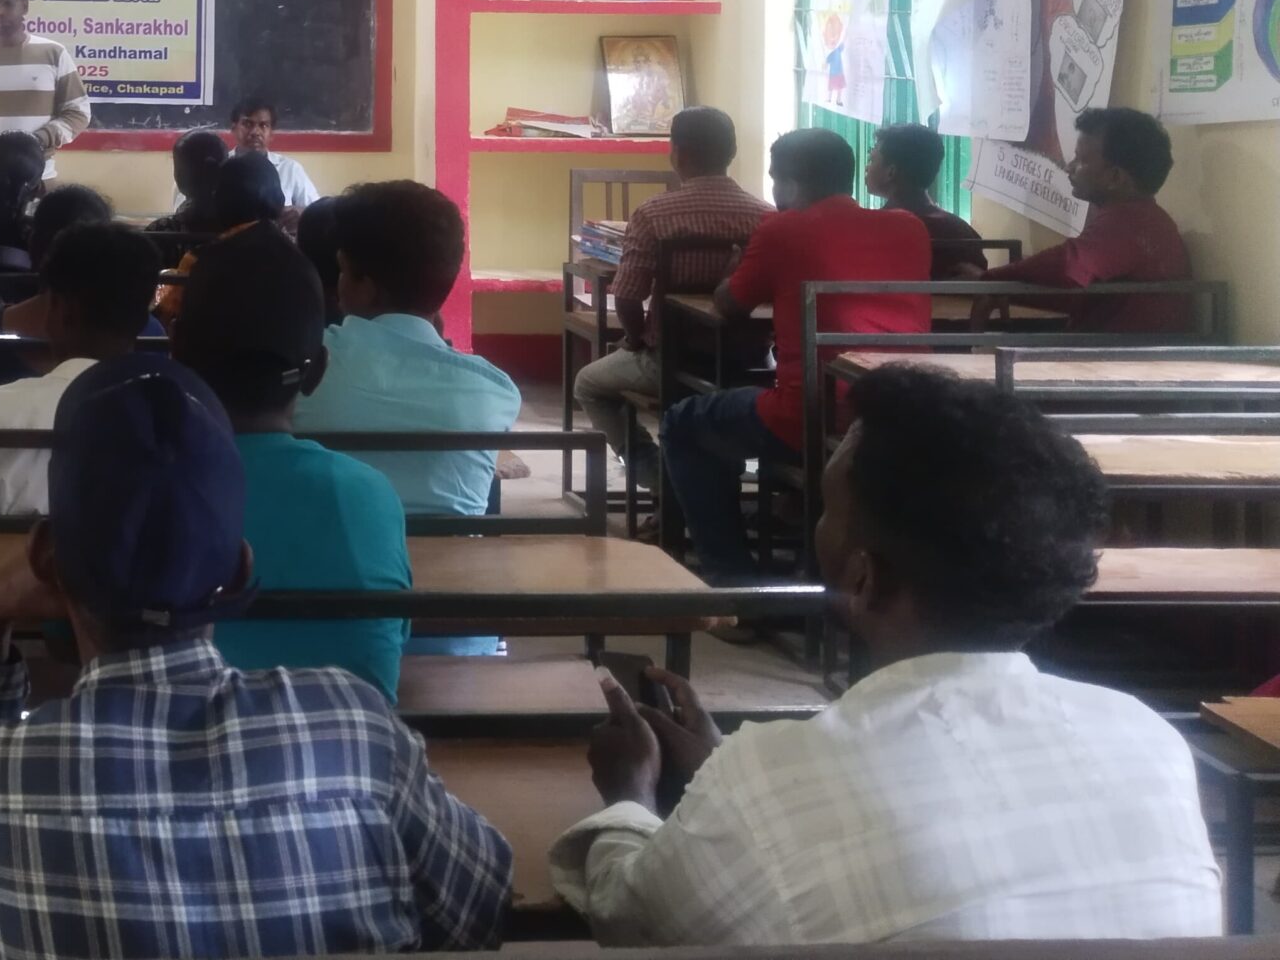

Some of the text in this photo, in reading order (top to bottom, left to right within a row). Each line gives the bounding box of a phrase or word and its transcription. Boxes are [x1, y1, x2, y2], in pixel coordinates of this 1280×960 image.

[83, 17, 189, 36] Sankarakhol
[75, 45, 168, 60] Kandhamal
[77, 65, 109, 77] 025
[117, 83, 184, 96] Chakapad
[997, 146, 1055, 185] 5 STAGES OF
[994, 163, 1079, 217] LANGUAGE DEVELOPMENT
